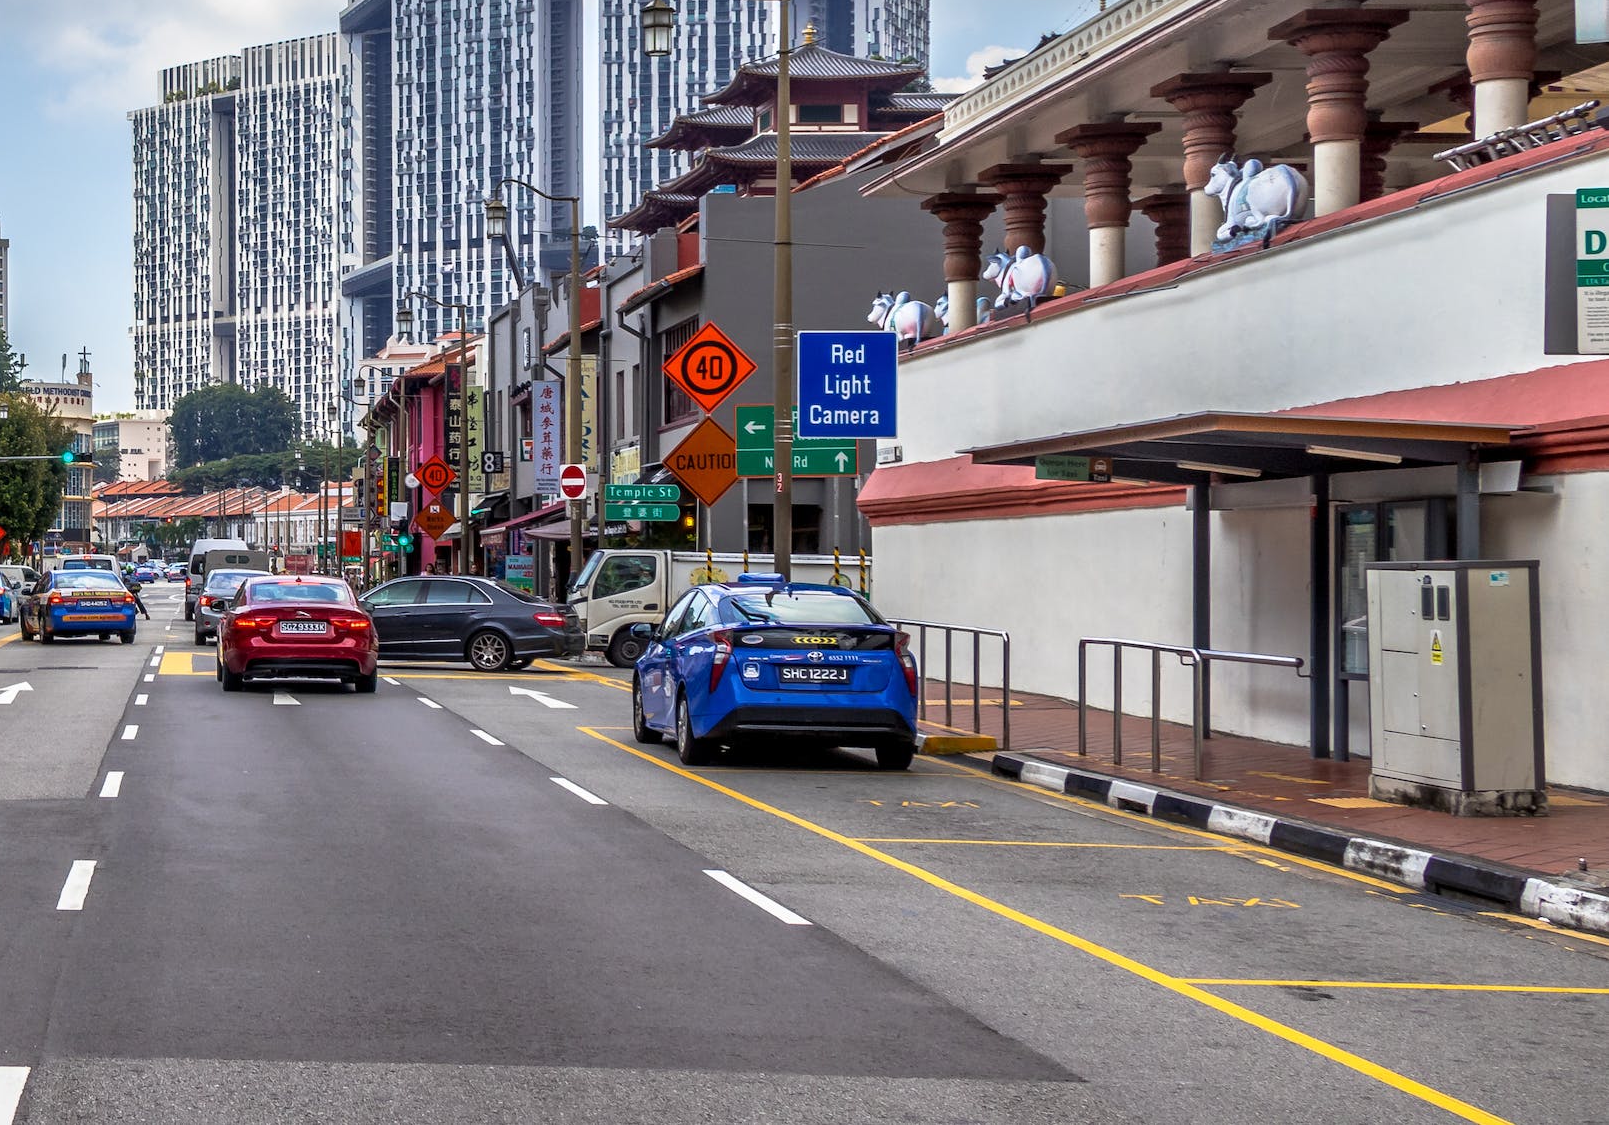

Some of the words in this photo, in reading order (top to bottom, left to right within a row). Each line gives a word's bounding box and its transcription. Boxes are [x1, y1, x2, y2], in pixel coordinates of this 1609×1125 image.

[831, 343, 865, 364] Red
[696, 355, 723, 380] 40
[43, 387, 80, 397] METHODIST
[824, 374, 871, 400] Light
[810, 404, 879, 425] Camera
[483, 452, 495, 473] 8
[793, 455, 808, 468] Rd
[429, 469, 442, 482] 40
[777, 472, 783, 493] 32
[609, 486, 654, 499] Temple
[659, 486, 672, 498] St
